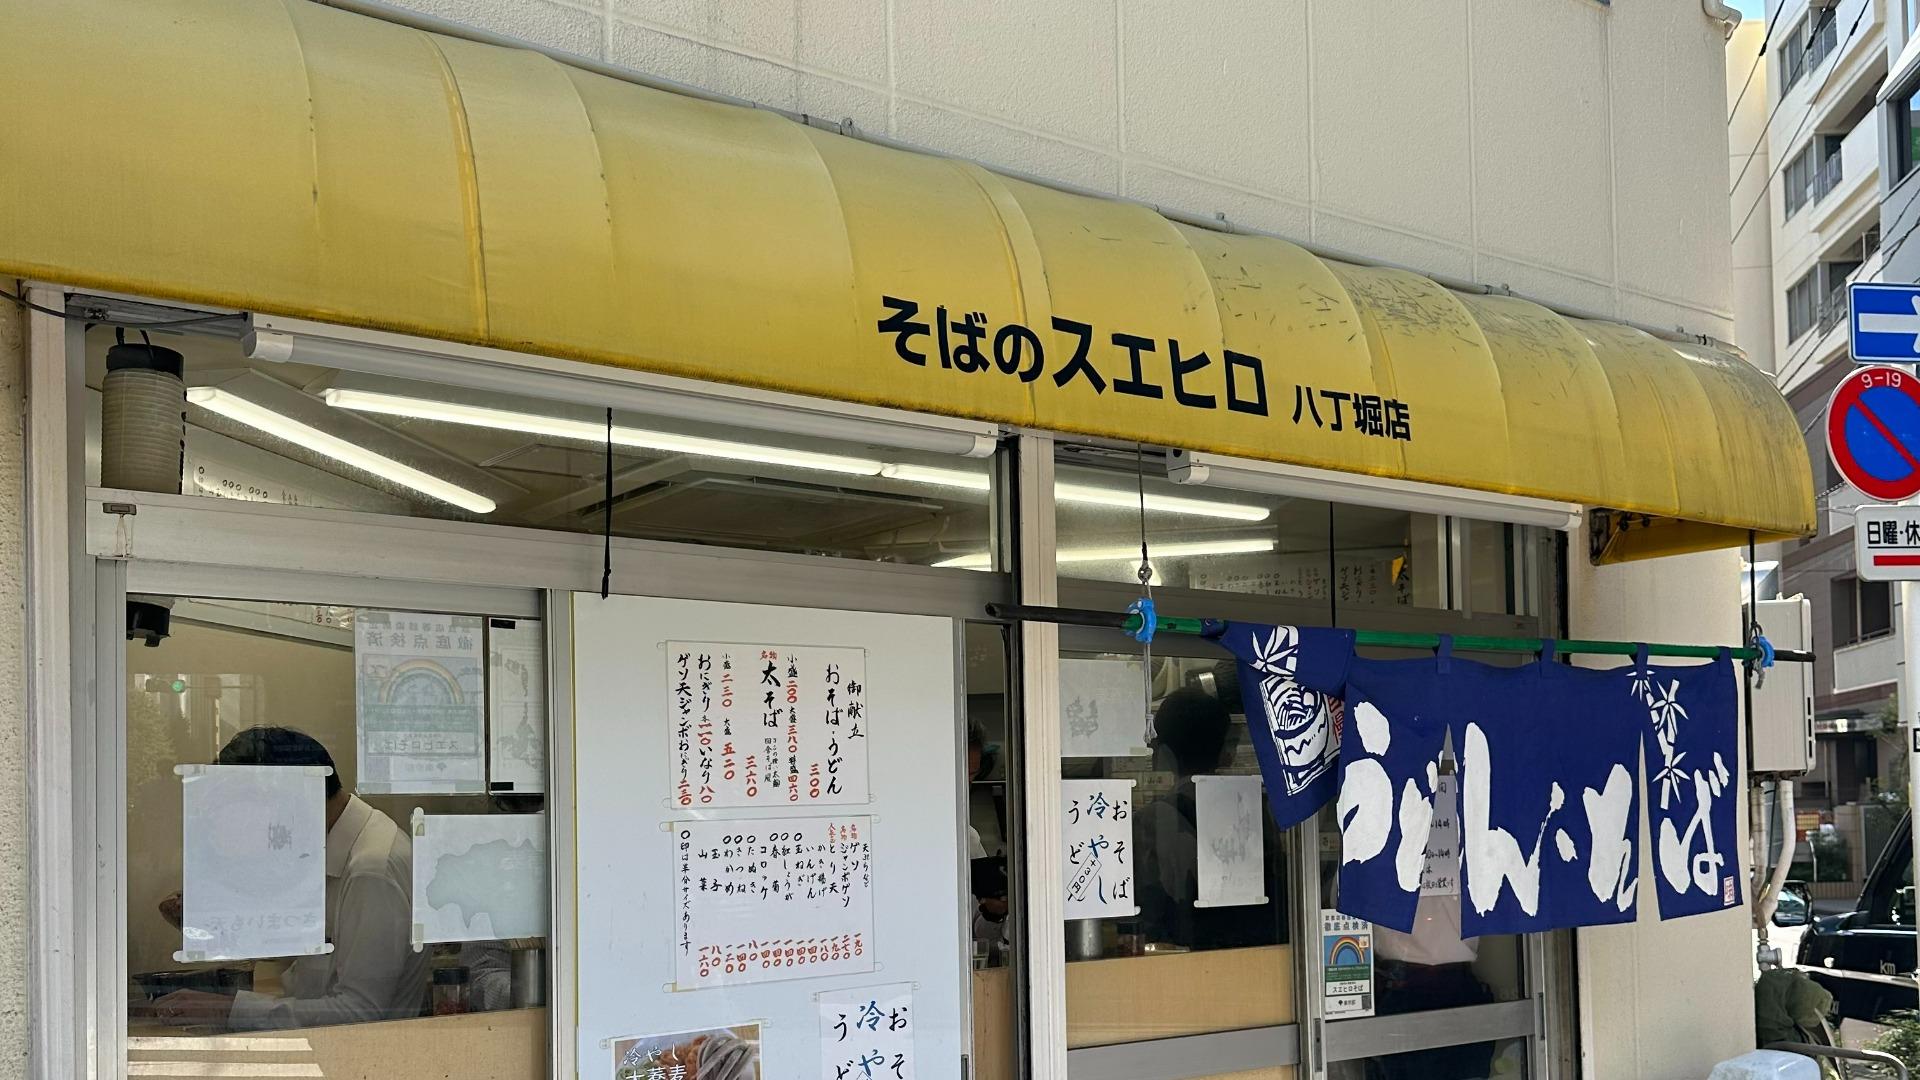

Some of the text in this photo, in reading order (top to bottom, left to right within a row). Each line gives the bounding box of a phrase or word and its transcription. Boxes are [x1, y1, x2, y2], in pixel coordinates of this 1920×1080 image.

[877, 295, 1412, 441] そばのスエヒロ 八丁堀店
[1861, 372, 1902, 389] 9-19
[761, 660, 783, 727] 太そば
[846, 680, 864, 739] 御献立
[1087, 792, 1110, 905] 冷やし
[1113, 799, 1131, 899] おそば
[1880, 960, 1896, 975] km
[623, 1043, 679, 1066] 冷やし
